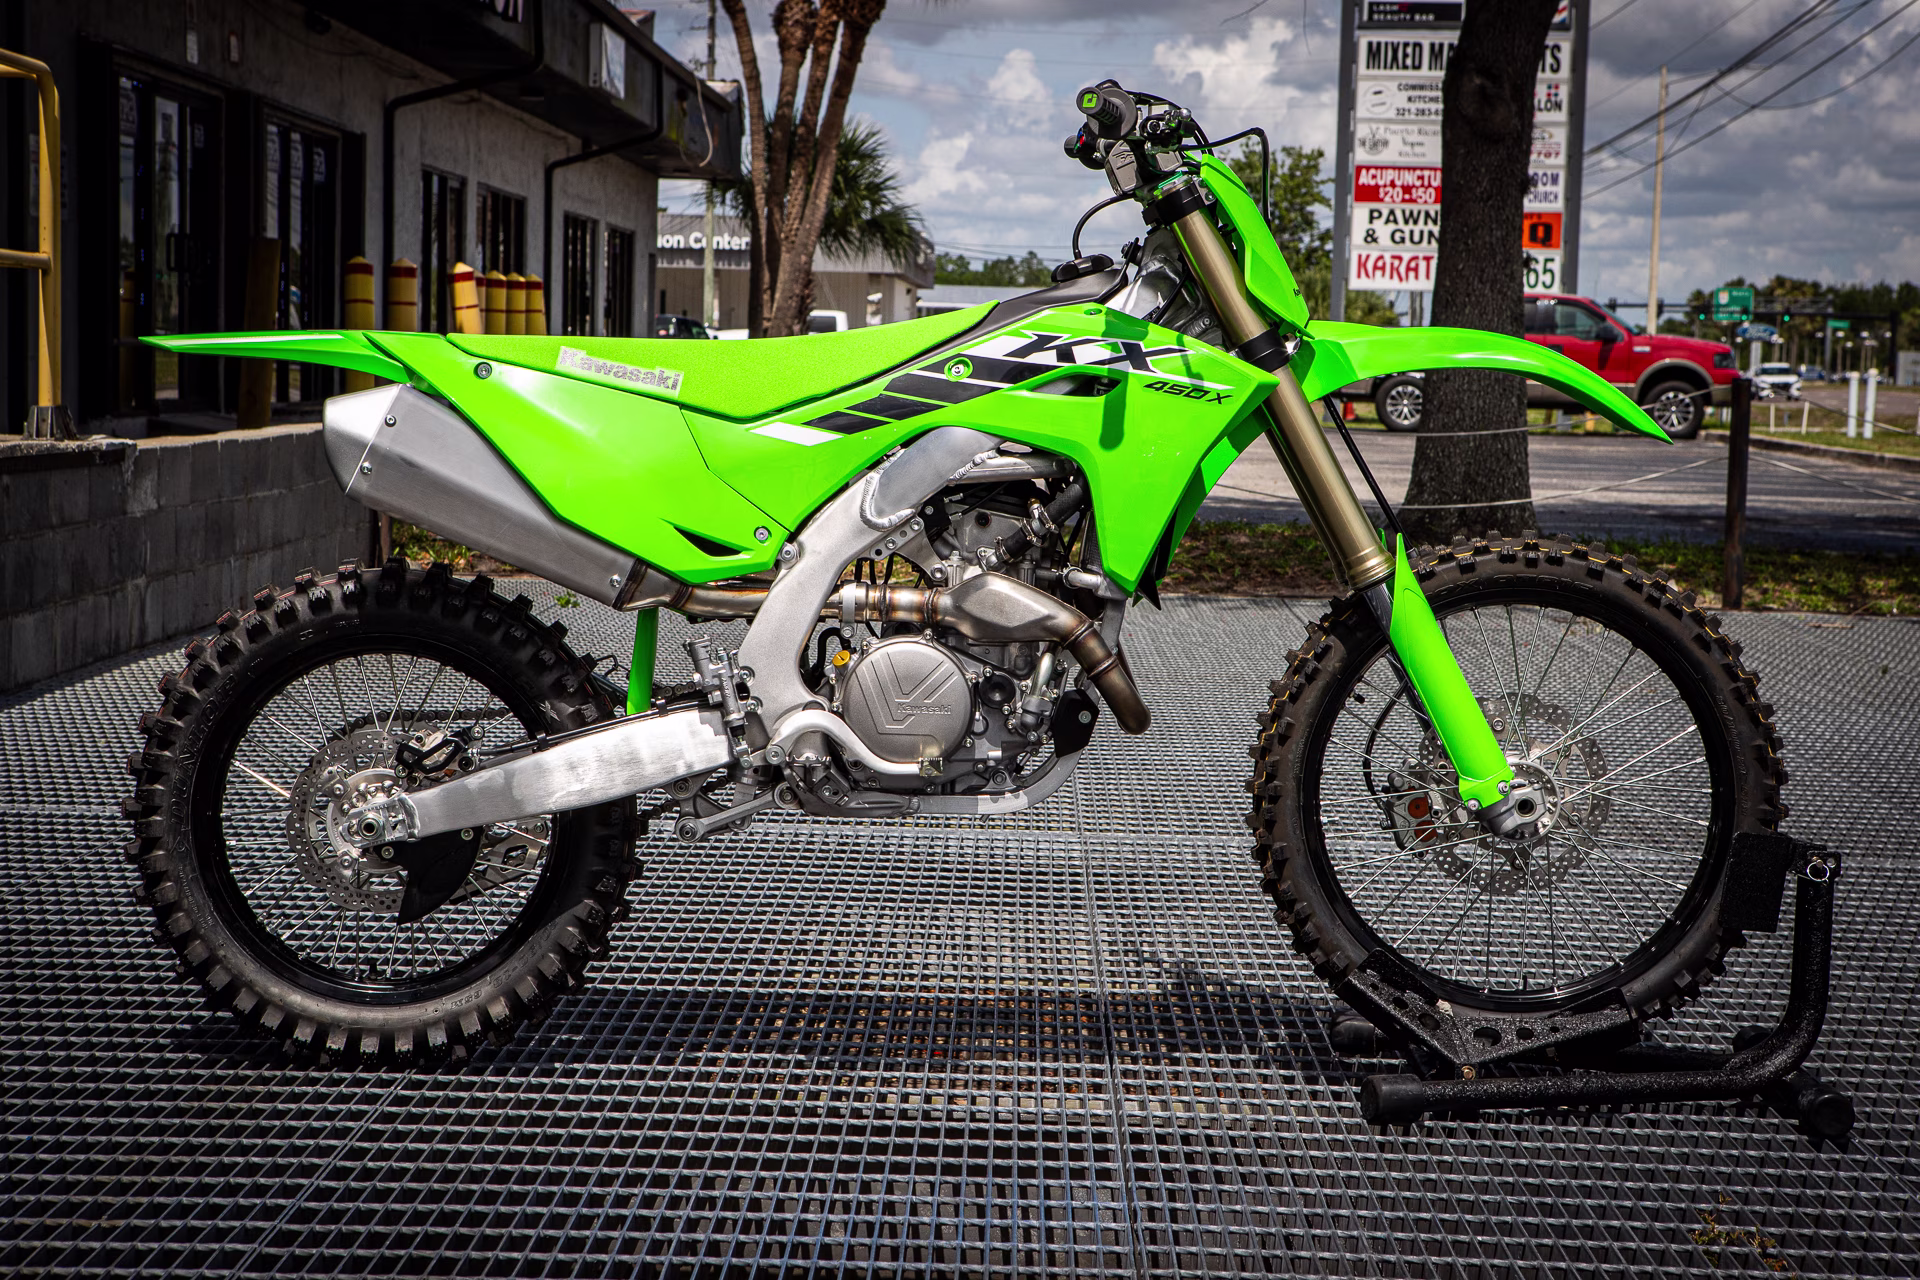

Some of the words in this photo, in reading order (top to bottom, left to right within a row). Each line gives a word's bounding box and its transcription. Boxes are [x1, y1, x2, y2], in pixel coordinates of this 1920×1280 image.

[1372, 13, 1410, 21] BEAUTY
[1413, 14, 1435, 22] BAR
[1366, 41, 1423, 71] MIXED
[1397, 82, 1441, 92] COMMISS
[1358, 168, 1442, 188] ACUPUNCTU
[1369, 208, 1439, 226] PAWN
[1364, 228, 1379, 245] &
[1529, 222, 1553, 247] Q
[1002, 331, 1191, 375] KX
[559, 348, 681, 391] Kawasaki
[897, 702, 952, 715] Kawasaki
[169, 673, 238, 826] DUNLOP
